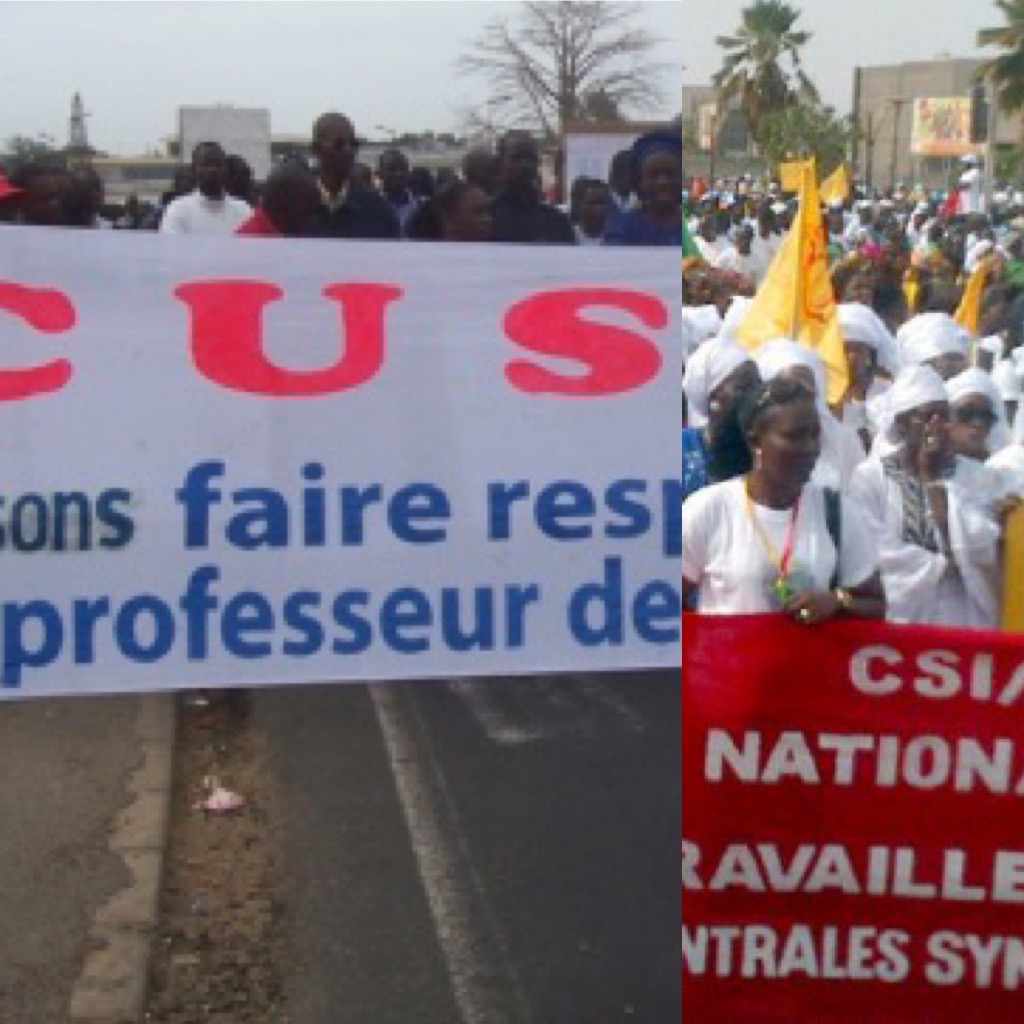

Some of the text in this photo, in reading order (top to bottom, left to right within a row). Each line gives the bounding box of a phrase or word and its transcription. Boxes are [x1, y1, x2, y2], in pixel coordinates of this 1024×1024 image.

[0, 487, 135, 553] ons
[176, 462, 450, 548] faire
[2, 556, 681, 687] professeur de
[682, 924, 909, 983] NTRALES
